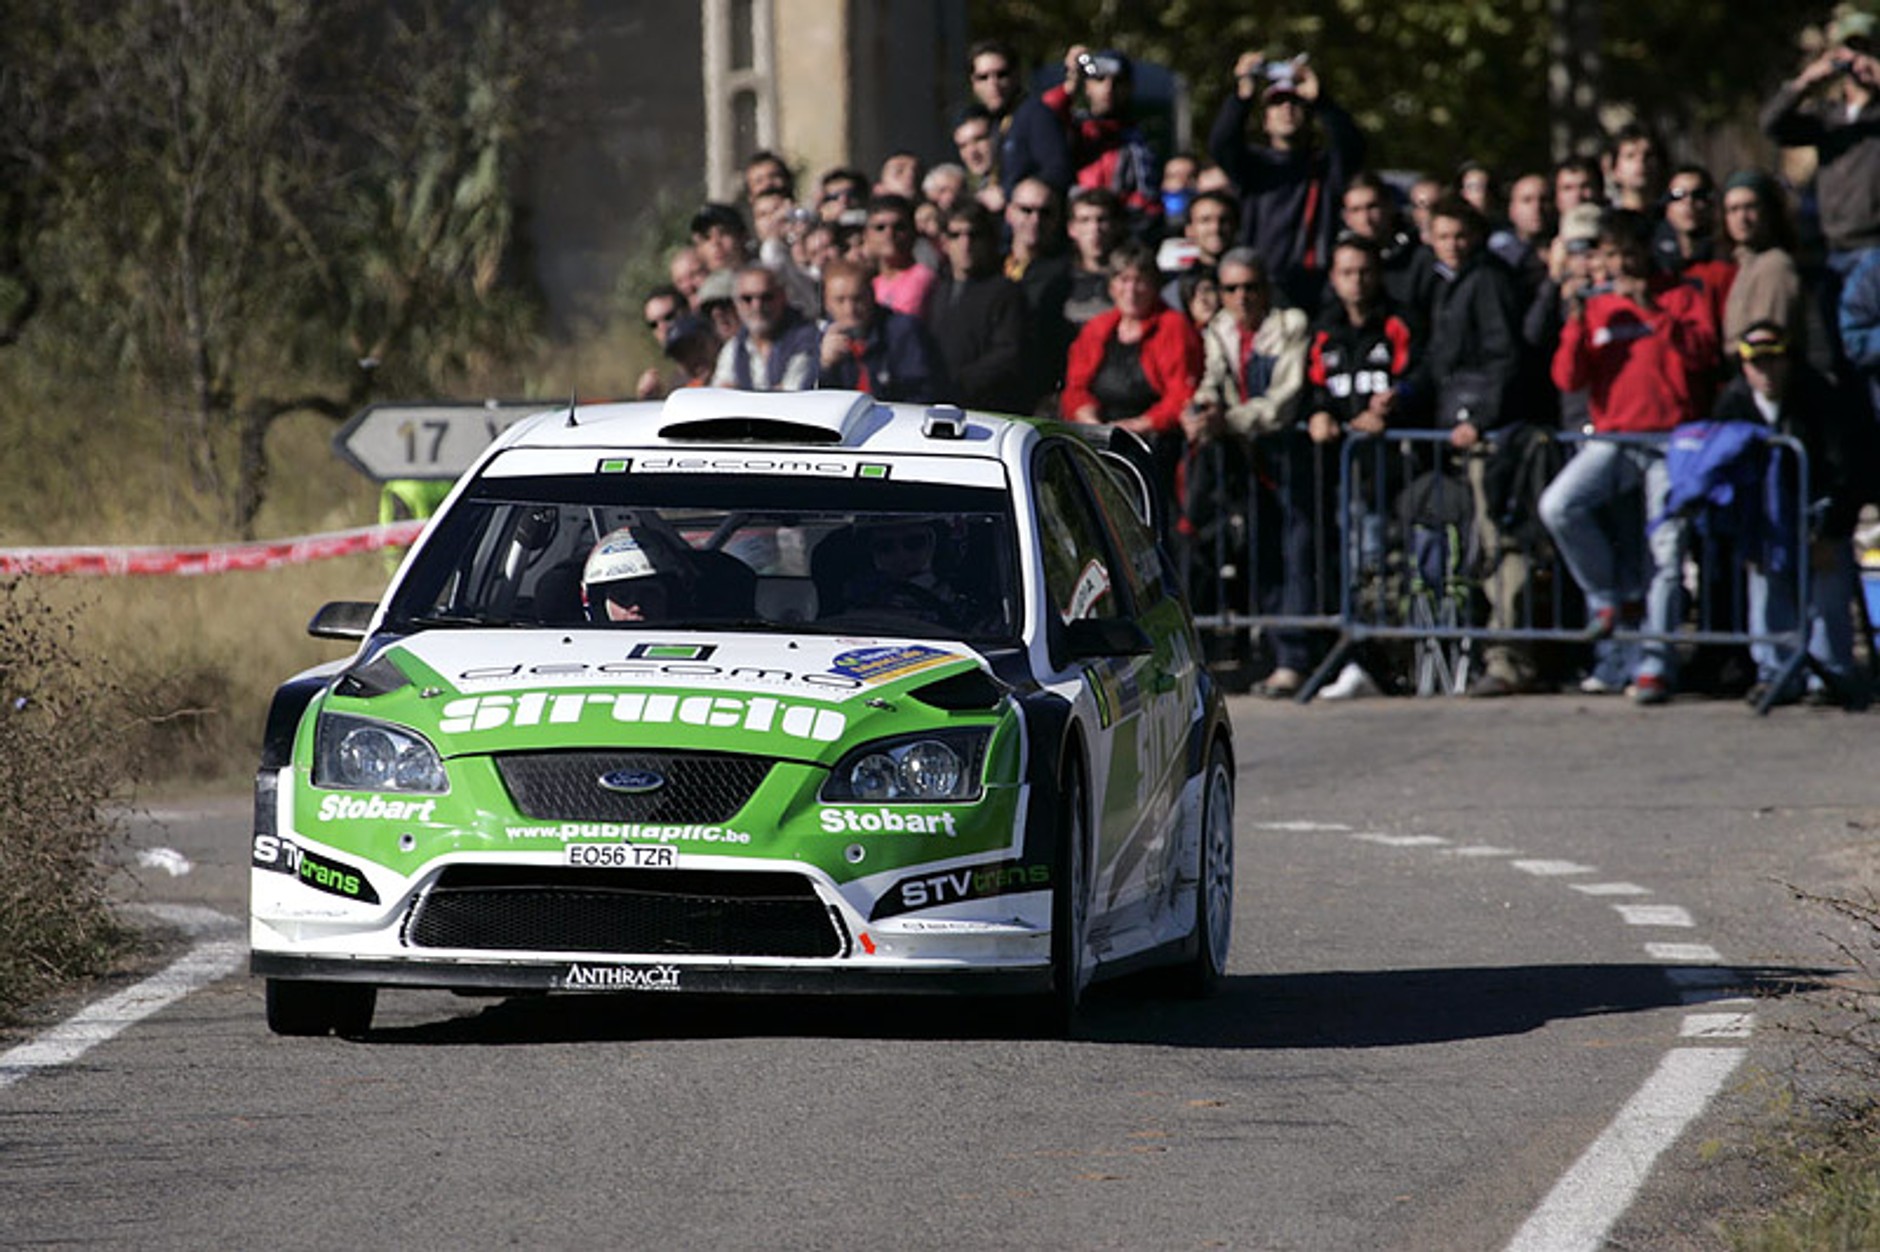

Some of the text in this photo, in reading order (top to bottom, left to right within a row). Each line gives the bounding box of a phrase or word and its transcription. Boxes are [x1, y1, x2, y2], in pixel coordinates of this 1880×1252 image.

[397, 421, 449, 463] 17
[439, 692, 847, 741] structo
[318, 794, 436, 821] Stobart
[820, 808, 957, 836] Stobart
[569, 846, 673, 866] EO56 TZR
